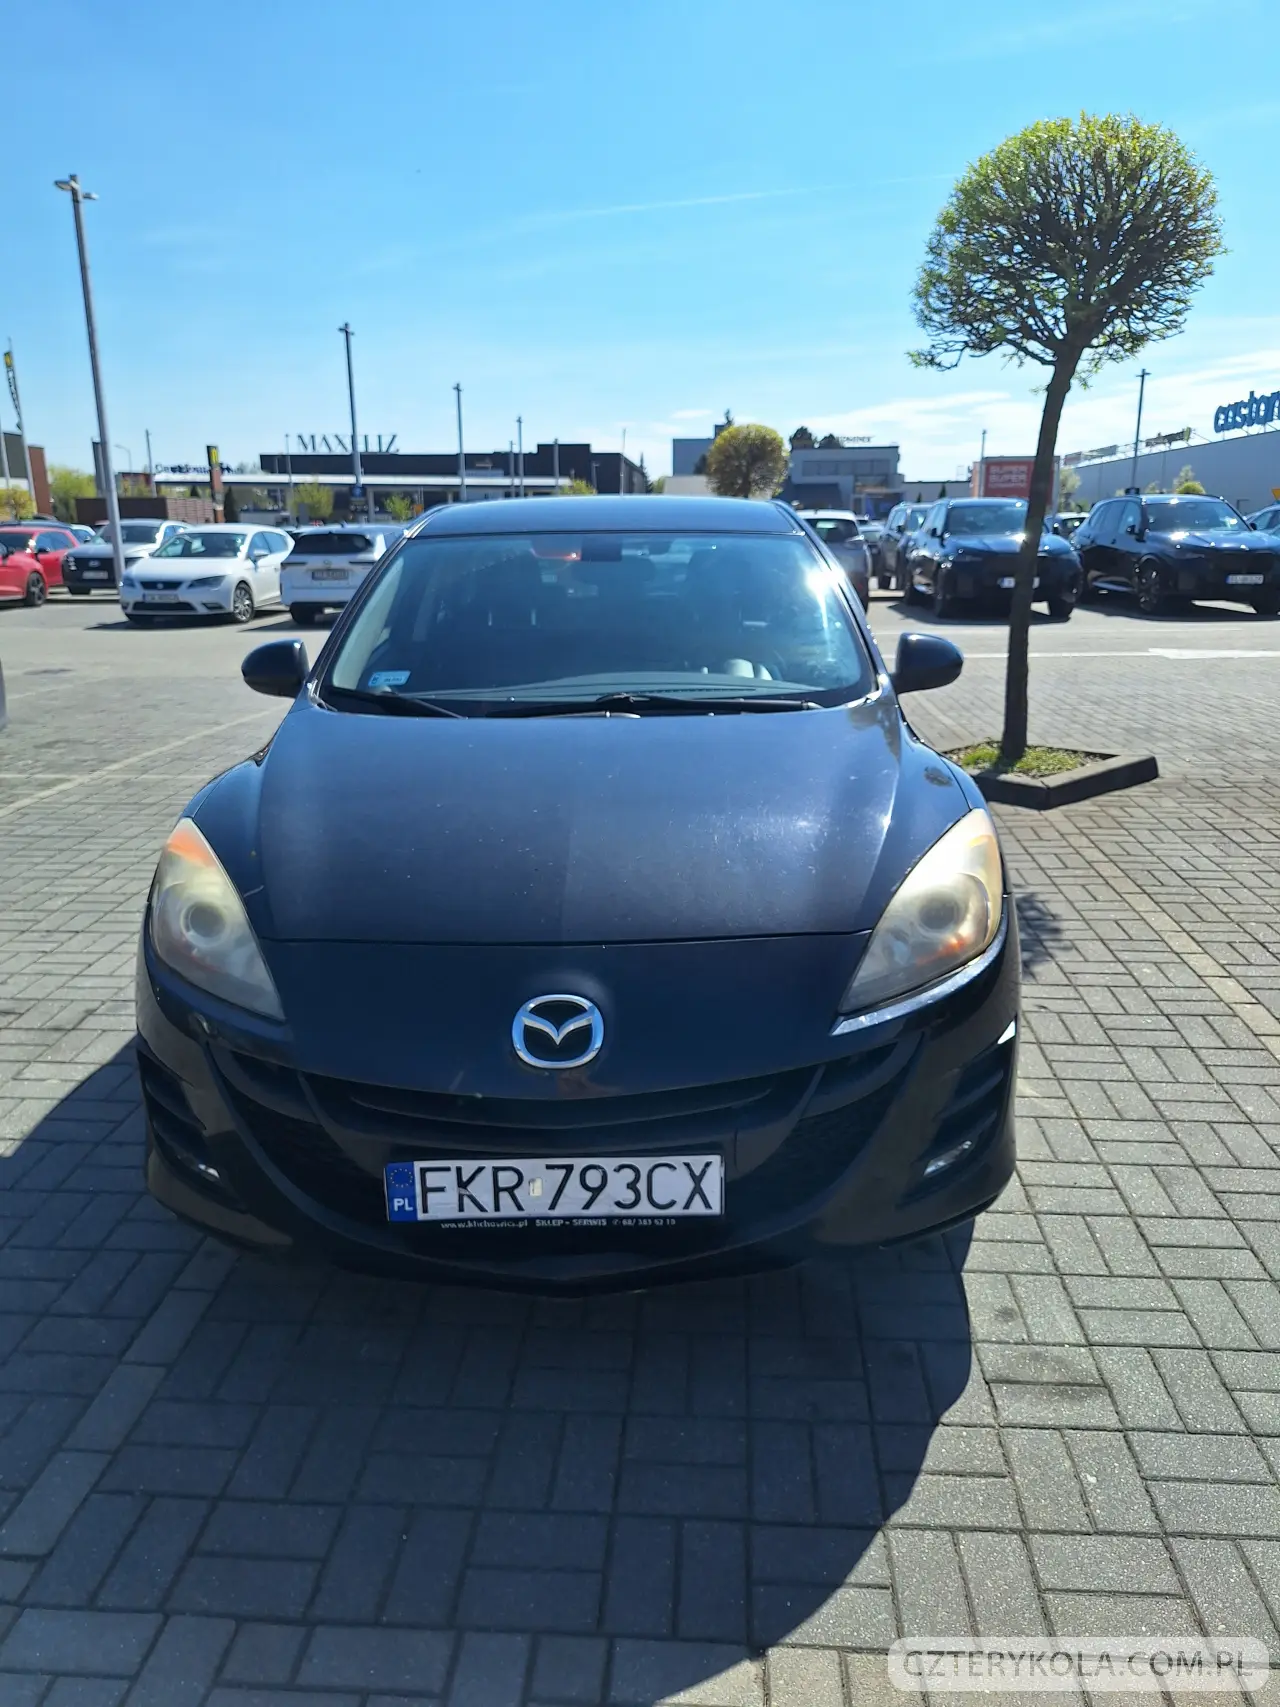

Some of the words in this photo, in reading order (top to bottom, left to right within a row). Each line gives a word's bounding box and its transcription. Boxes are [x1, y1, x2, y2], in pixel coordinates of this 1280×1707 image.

[1214, 390, 1280, 433] castor
[419, 1164, 525, 1214] FKR
[545, 1160, 714, 1211] 793CX
[393, 1197, 414, 1212] PL
[535, 1218, 564, 1227] SKLEP
[572, 1218, 607, 1227] SERWIS
